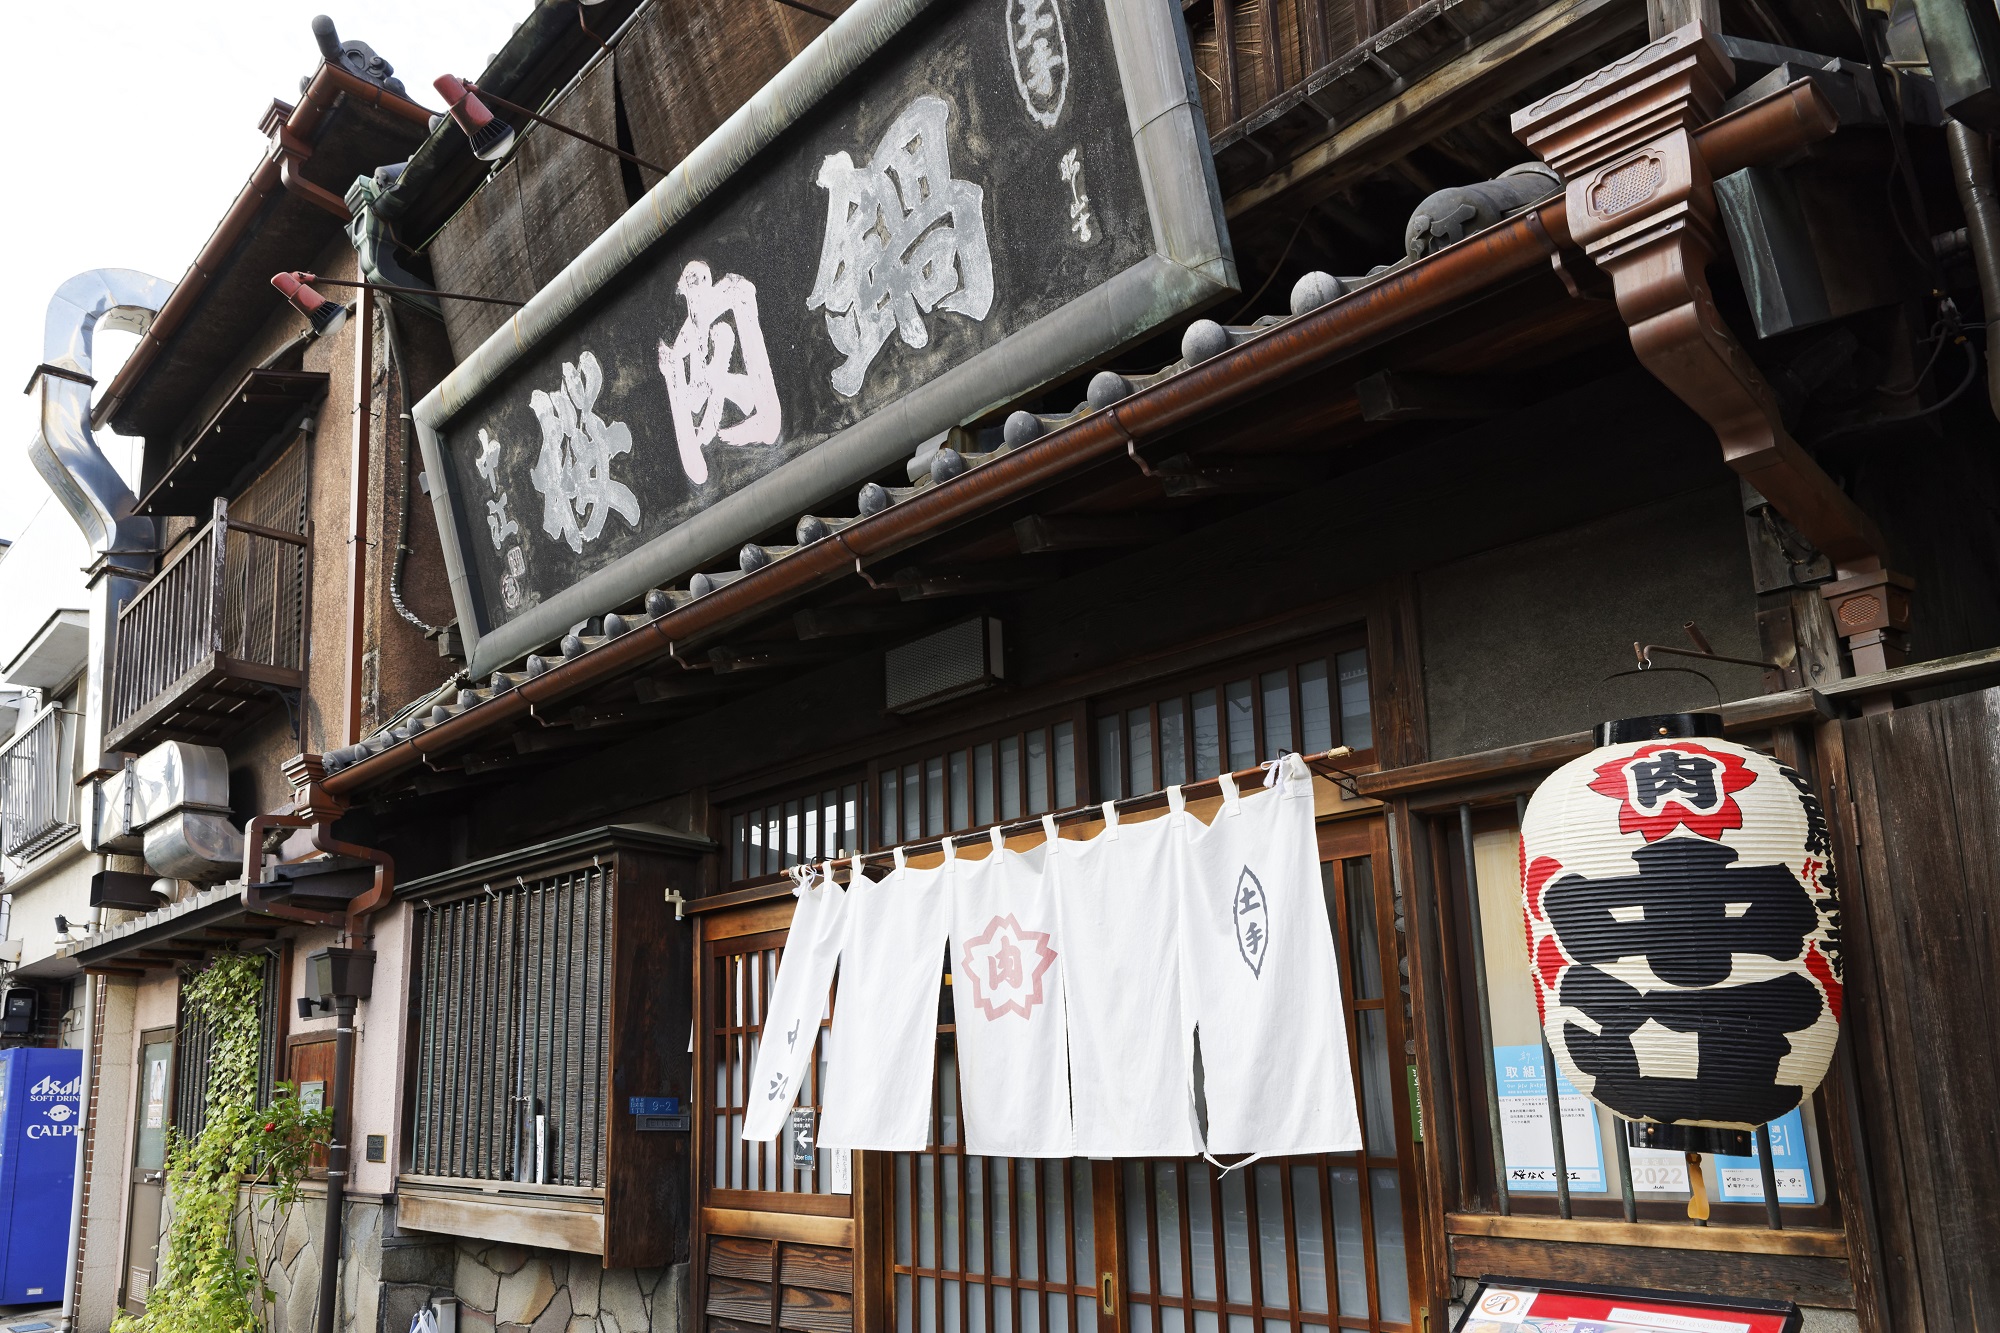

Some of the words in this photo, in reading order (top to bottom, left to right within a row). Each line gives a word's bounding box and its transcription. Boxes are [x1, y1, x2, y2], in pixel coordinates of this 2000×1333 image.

[1629, 751, 1718, 810] 肉
[1238, 886, 1263, 955] 土手
[986, 934, 1024, 991] 肉
[652, 1101, 672, 1111] 9-2
[1633, 1167, 1683, 1185] 2022
[1614, 1311, 1653, 1322] English
